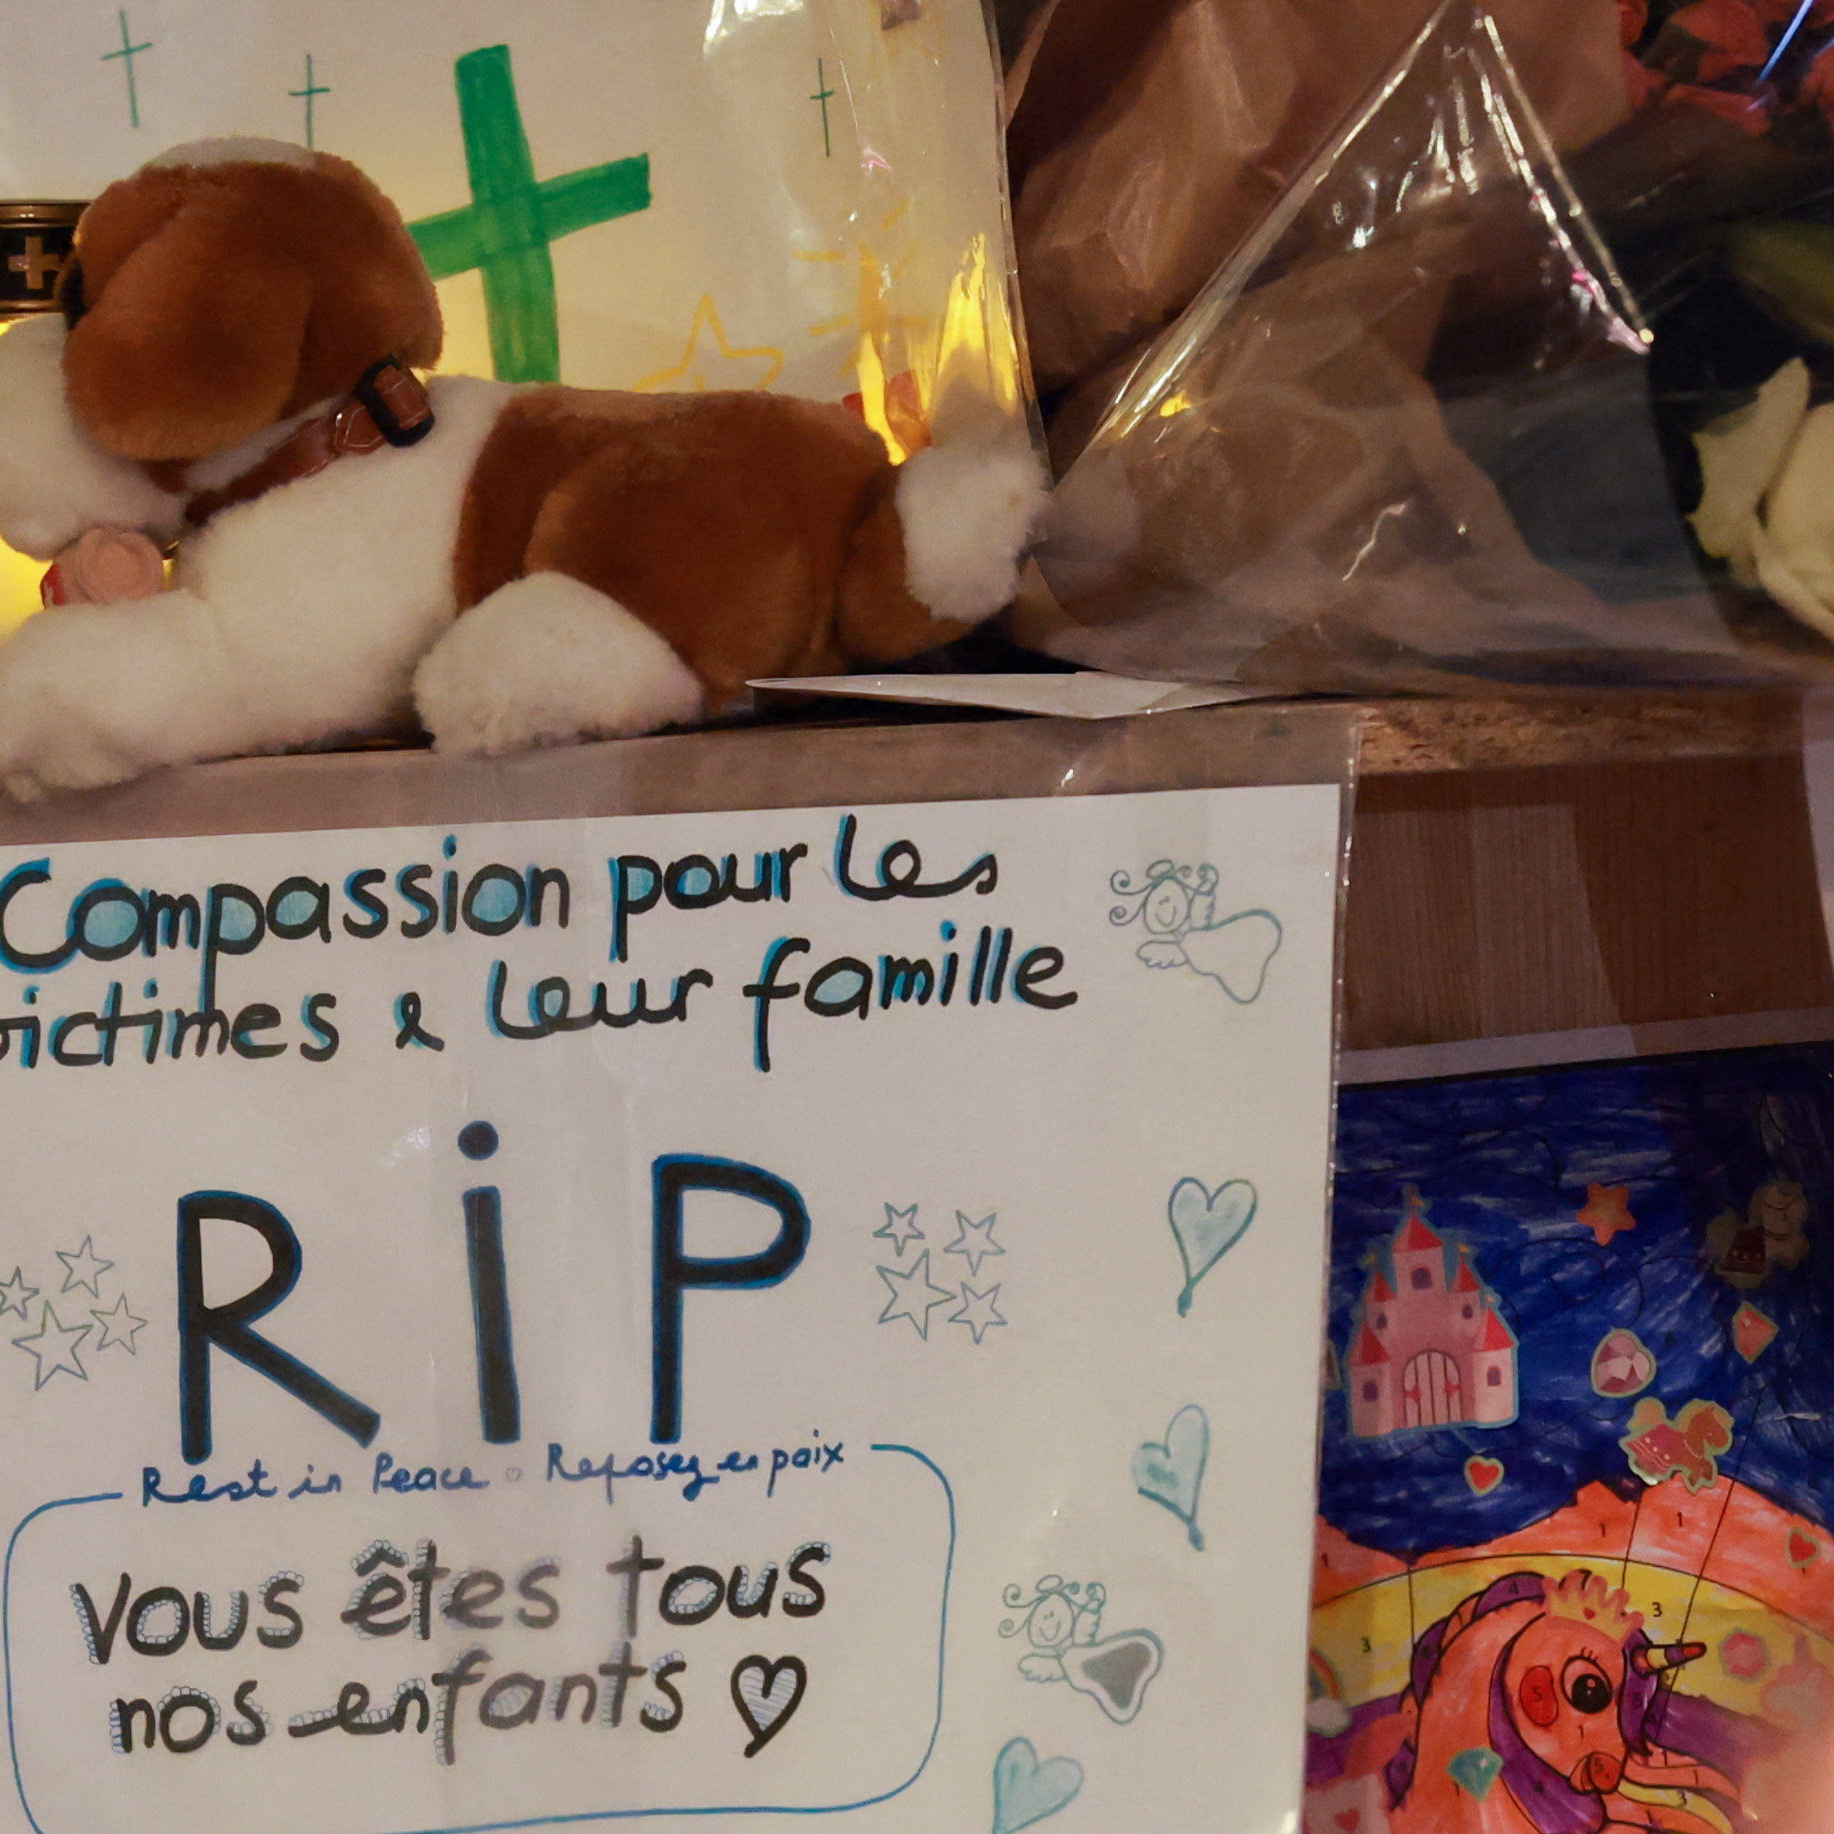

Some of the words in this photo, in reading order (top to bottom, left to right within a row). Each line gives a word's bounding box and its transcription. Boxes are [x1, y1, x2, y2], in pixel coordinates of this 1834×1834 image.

[609, 843, 808, 962] pour
[742, 920, 1078, 1073] famille
[142, 1458, 278, 1508] Rest
[287, 1464, 342, 1499] in
[372, 1451, 491, 1495] Peace
[547, 1443, 720, 1506] Reposez
[718, 1451, 759, 1472] en
[767, 1429, 845, 1499] paix
[1677, 1512, 1683, 1527] 1
[340, 1538, 562, 1640] êtes
[603, 1529, 832, 1638] tous
[1652, 1602, 1663, 1617] 3
[1361, 1636, 1371, 1653] 3
[109, 1678, 272, 1755] nos
[287, 1641, 689, 1766] enfants
